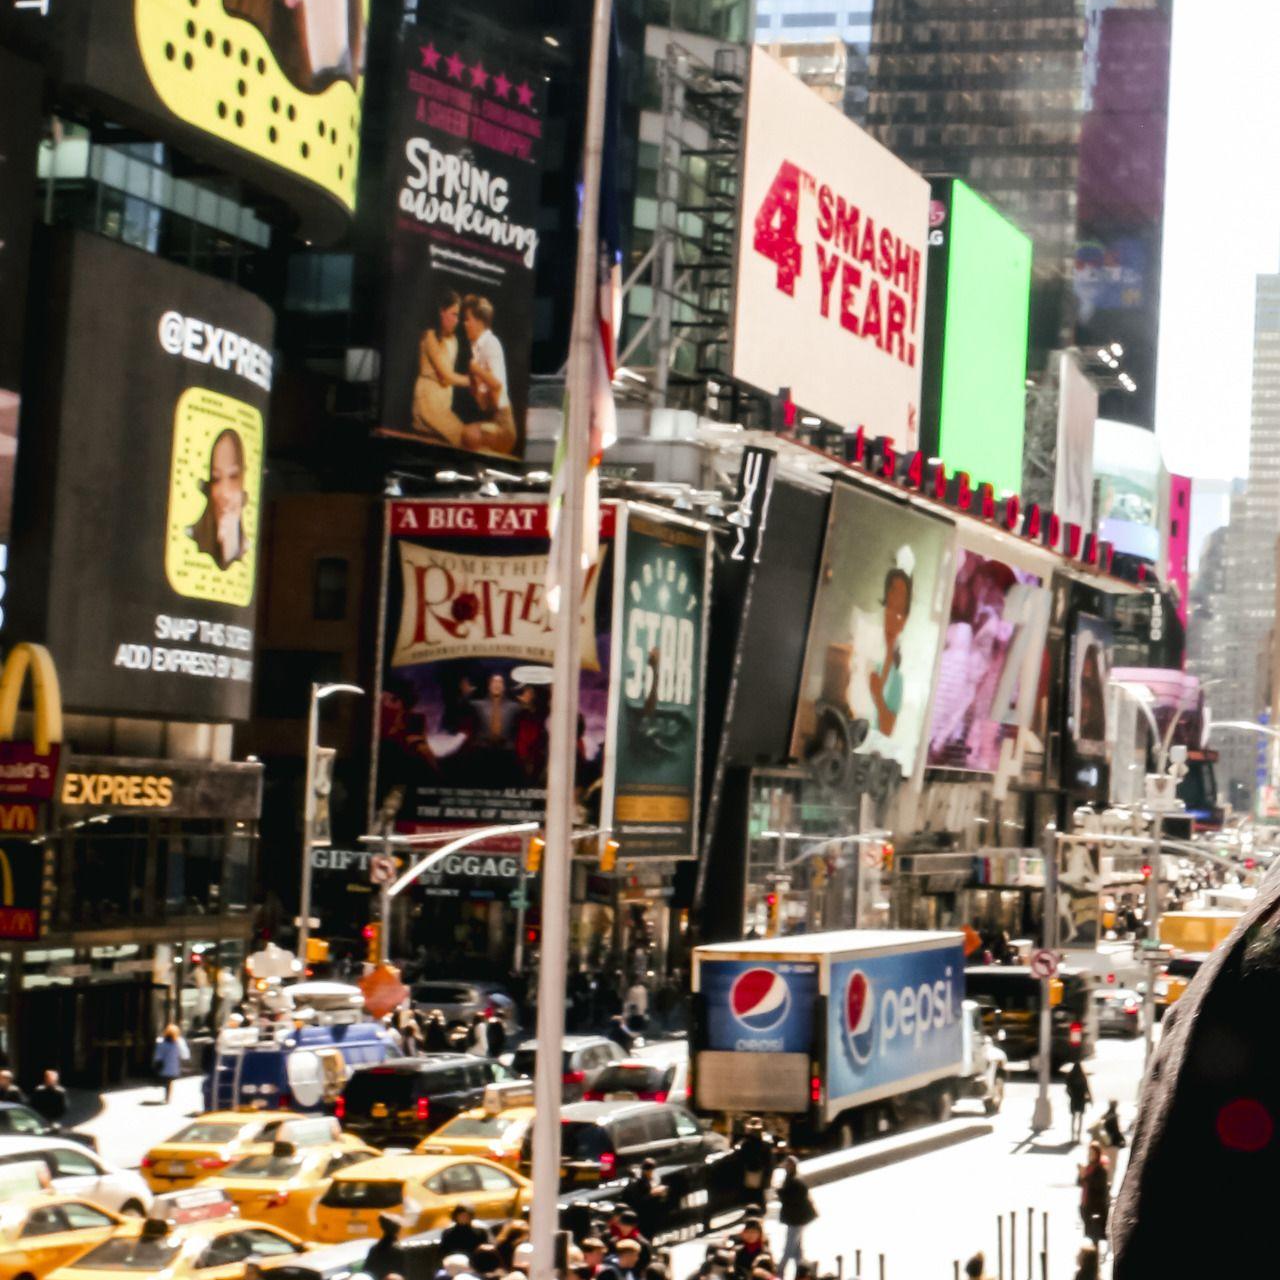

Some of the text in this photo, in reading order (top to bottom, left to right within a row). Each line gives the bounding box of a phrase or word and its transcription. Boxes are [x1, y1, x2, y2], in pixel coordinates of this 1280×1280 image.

[406, 136, 510, 213] SPRING
[487, 508, 539, 530] FAT
[61, 772, 174, 807] EXPRESS
[880, 965, 954, 1057] pepsi
